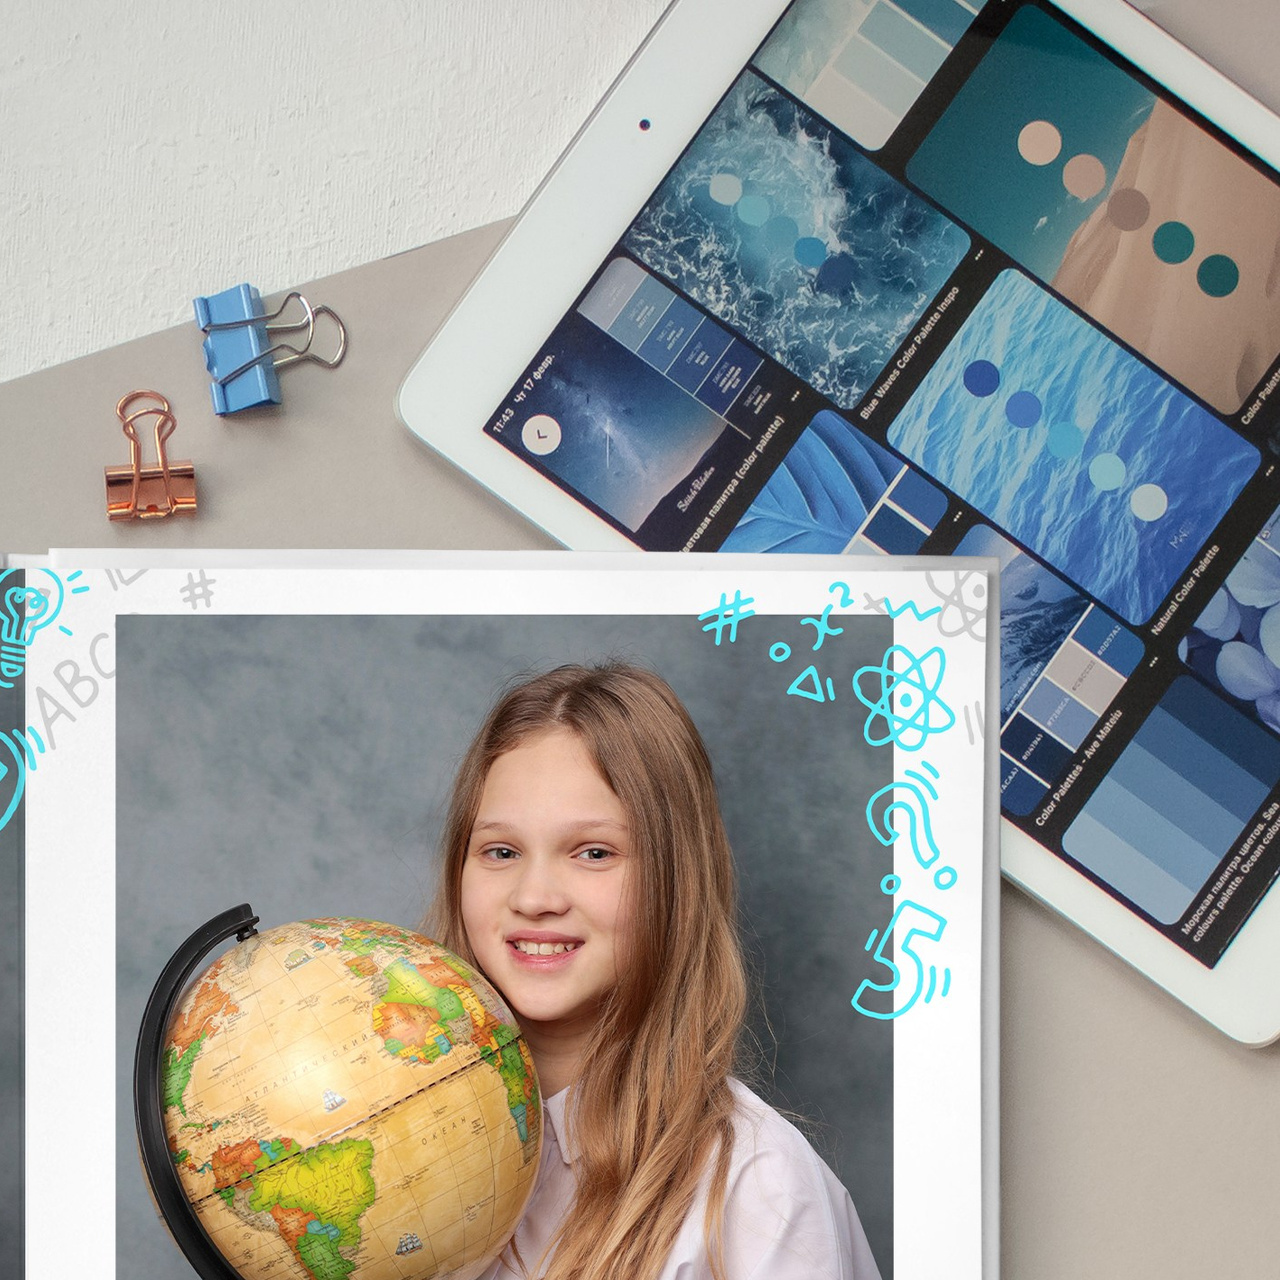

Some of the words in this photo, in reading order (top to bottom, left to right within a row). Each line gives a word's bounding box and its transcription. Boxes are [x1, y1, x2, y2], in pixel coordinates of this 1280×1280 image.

[492, 407, 515, 433] 11:43
[513, 390, 527, 403] Чт
[523, 377, 534, 391] 17
[532, 354, 556, 381] февр.
[859, 398, 879, 420] Blue
[874, 368, 901, 398] Waves
[896, 343, 918, 369] Color
[913, 311, 942, 345] Palette
[936, 286, 960, 313] Inspo
[1240, 398, 1262, 425] Color
[676, 488, 698, 513] Stitch
[708, 478, 740, 518] палитра
[734, 450, 758, 480] (color
[755, 415, 785, 454] palette)
[1150, 600, 1180, 636] Natural
[1174, 576, 1196, 602] Color
[1192, 544, 1220, 578] Palette
[1035, 800, 1057, 827] Color
[1052, 764, 1083, 802] Palettes
[1084, 740, 1101, 760] Ave
[1180, 893, 1215, 935] Морская
[1211, 855, 1242, 895] палитра
[1238, 822, 1267, 857] цветов.
[1262, 802, 1280, 821] Sea
[1192, 908, 1220, 943] colours
[1216, 876, 1245, 910] palette.
[1240, 844, 1266, 874] Ocean
[421, 1116, 467, 1146] ОКЕАН
